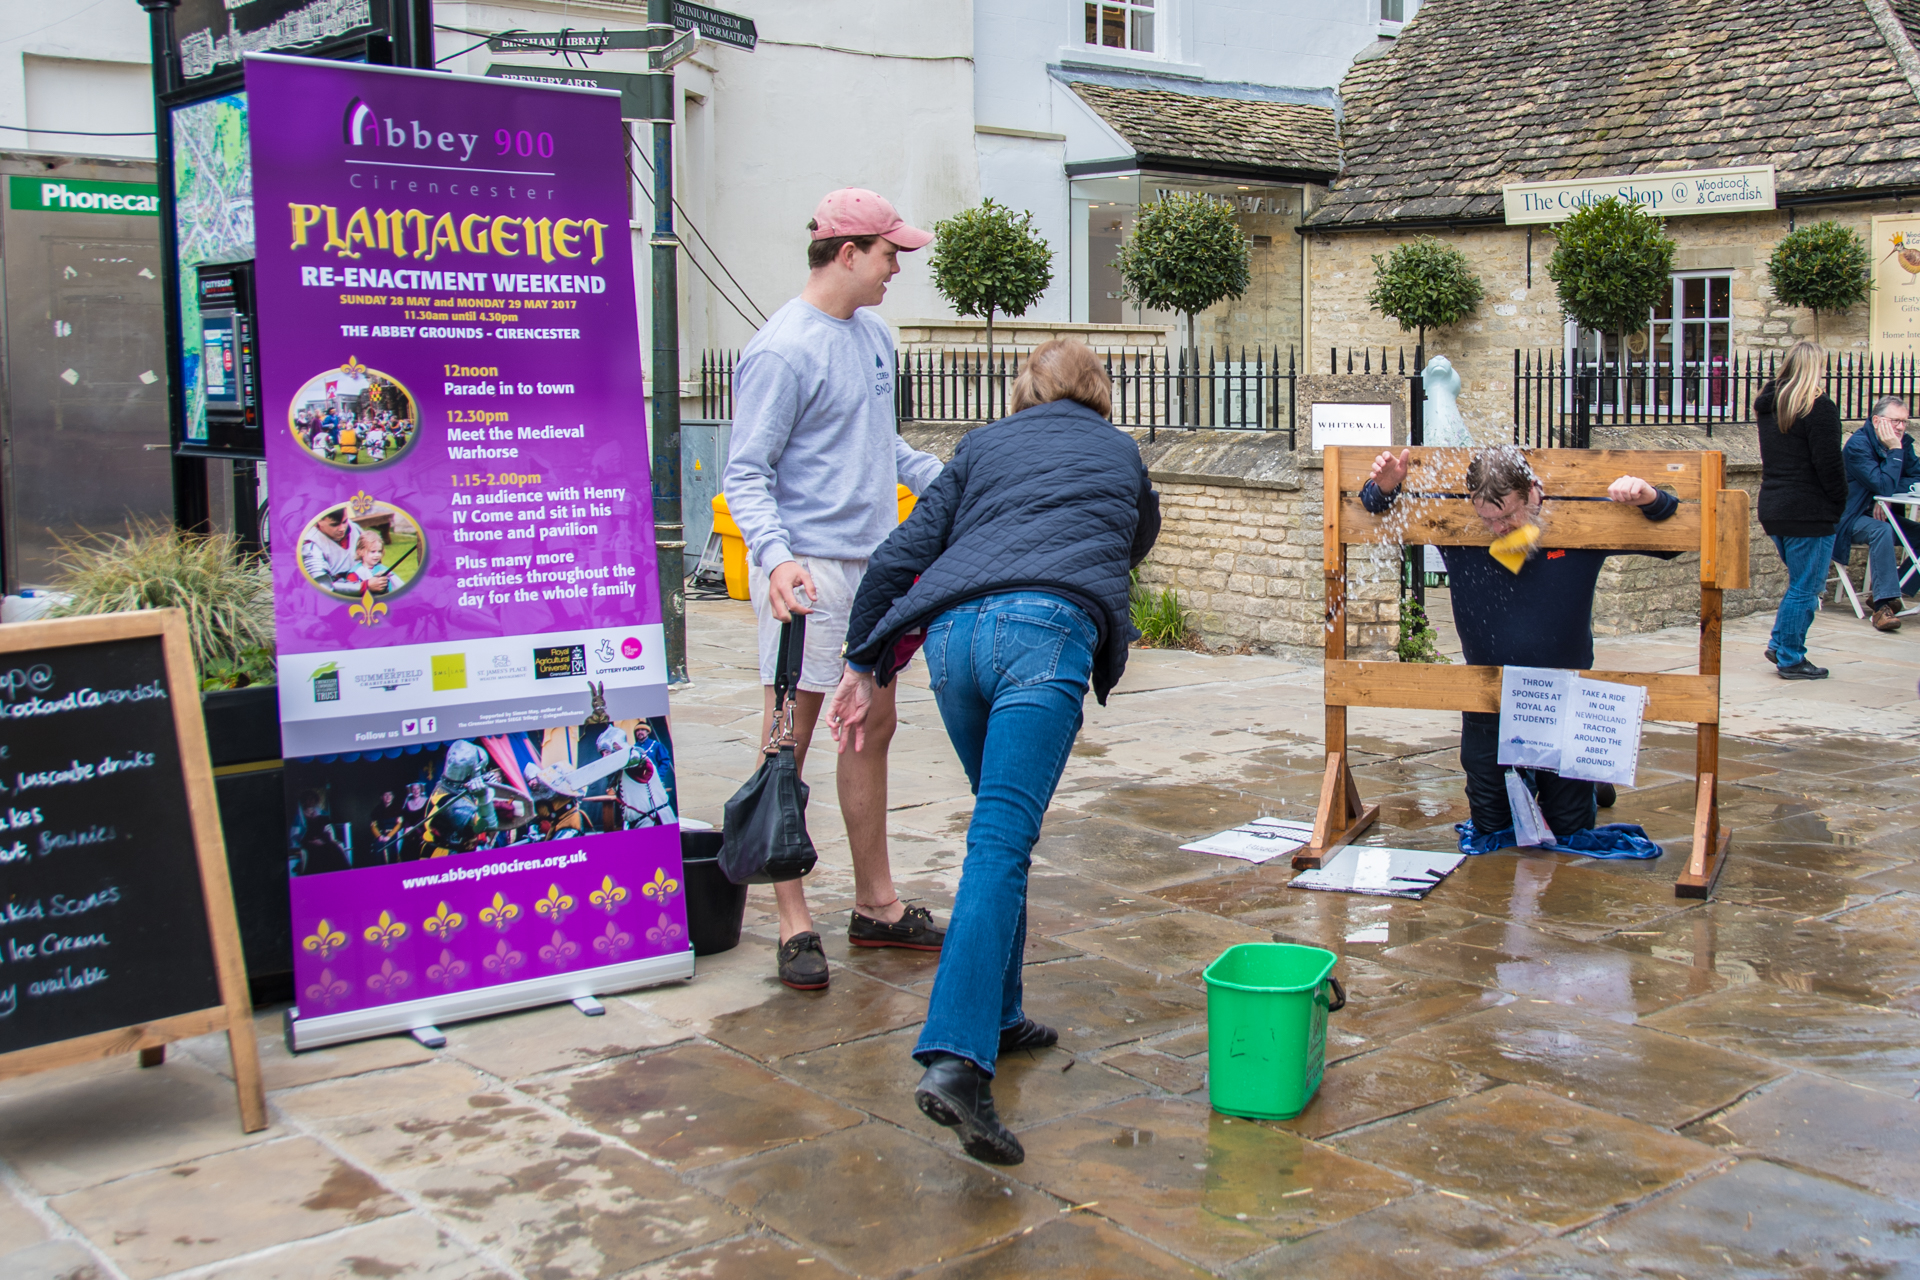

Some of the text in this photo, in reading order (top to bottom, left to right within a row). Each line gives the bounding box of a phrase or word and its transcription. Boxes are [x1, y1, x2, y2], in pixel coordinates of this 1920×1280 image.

[710, 12, 740, 30] MUSEUM
[700, 22, 749, 44] INFORMATION
[502, 37, 555, 47] BINGHAM
[566, 78, 598, 88] ARTS
[342, 96, 554, 161] Abbey 900
[350, 173, 555, 200] Cirencester
[1695, 175, 1749, 191] Woodcock
[1521, 182, 1689, 211] The Coffee Shop @
[1696, 188, 1762, 204] & Cavendish
[288, 202, 608, 265] PLANTAGENET
[301, 266, 606, 294] RE-ENACTMENT WEEKEND
[340, 294, 577, 309] SUNDAY 28 MAY and MONDAY 29 MAY 2017
[404, 310, 518, 324] 11.30am until 4.30pm
[340, 325, 580, 340] THE ABBEY GROUNDS CIRENCESTER
[1883, 331, 1905, 339] Home
[444, 365, 498, 377] 12noon
[444, 381, 575, 395] Parade in to town
[447, 410, 509, 425] 12.30pm
[447, 424, 584, 441] Meet the Medieval
[448, 445, 518, 459] Warhorse
[451, 473, 541, 488] 1.15-2.00pm
[451, 487, 625, 505] An audience with Henry
[453, 503, 612, 523] IV Come and sit in his
[453, 522, 598, 542] throne and pavilion
[455, 552, 575, 569] Plus many more
[457, 563, 636, 588] activities throughout the
[458, 580, 636, 609] day for the whole family
[551, 648, 569, 657] Royal
[535, 656, 570, 666] Agricultural
[540, 663, 571, 673] University
[355, 669, 423, 683] SUMMERFIELD
[509, 666, 527, 674] PLACE
[360, 679, 398, 687] CHARITABLE
[1522, 678, 1553, 688] THROW
[317, 691, 338, 700] TRUST
[1512, 689, 1562, 701] SPONGES AT
[1582, 689, 1600, 699] TAKE
[1609, 694, 1626, 702] RIDE
[1516, 702, 1556, 713] ROYAL AG
[1599, 704, 1615, 712] OUR
[1513, 714, 1557, 725] STUDENTS!
[1575, 711, 1626, 725] NEWHOLLAND
[355, 730, 399, 741] Follow us
[1583, 723, 1616, 734] TRACTOR
[1574, 733, 1622, 746] AROUND THE
[1585, 746, 1608, 755] ABBEY
[97, 751, 155, 776] drinks
[1576, 756, 1615, 767] GROUNDS!
[402, 849, 587, 890] www.abbey900ciren.org.uk
[50, 886, 121, 917] Scones
[9, 937, 37, 961] Ice
[41, 933, 112, 956] Cream
[29, 965, 110, 996] available
